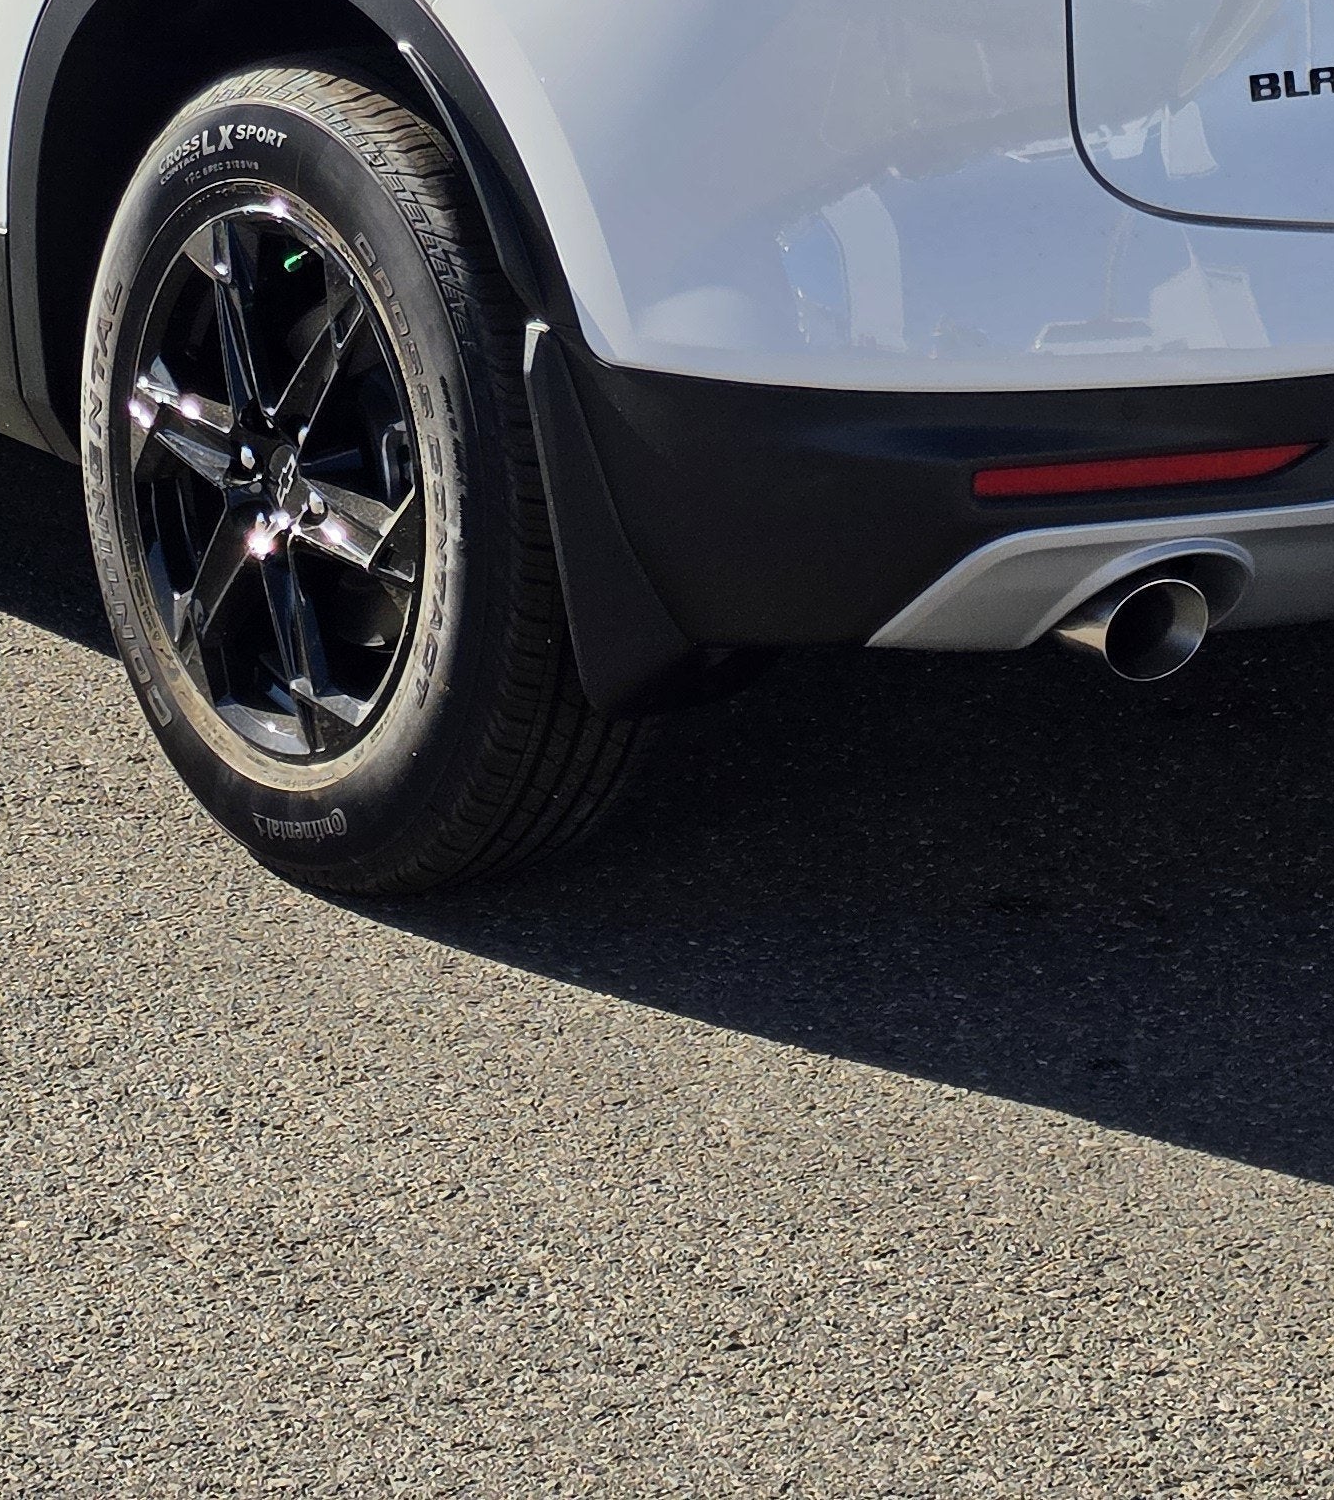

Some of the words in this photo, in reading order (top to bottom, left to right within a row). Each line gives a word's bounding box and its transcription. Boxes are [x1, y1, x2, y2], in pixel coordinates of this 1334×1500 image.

[158, 134, 200, 175] CROSS
[202, 124, 234, 156] LX
[235, 124, 288, 148] SPORT
[160, 150, 201, 186] CONTACT
[251, 807, 348, 843] Continental
